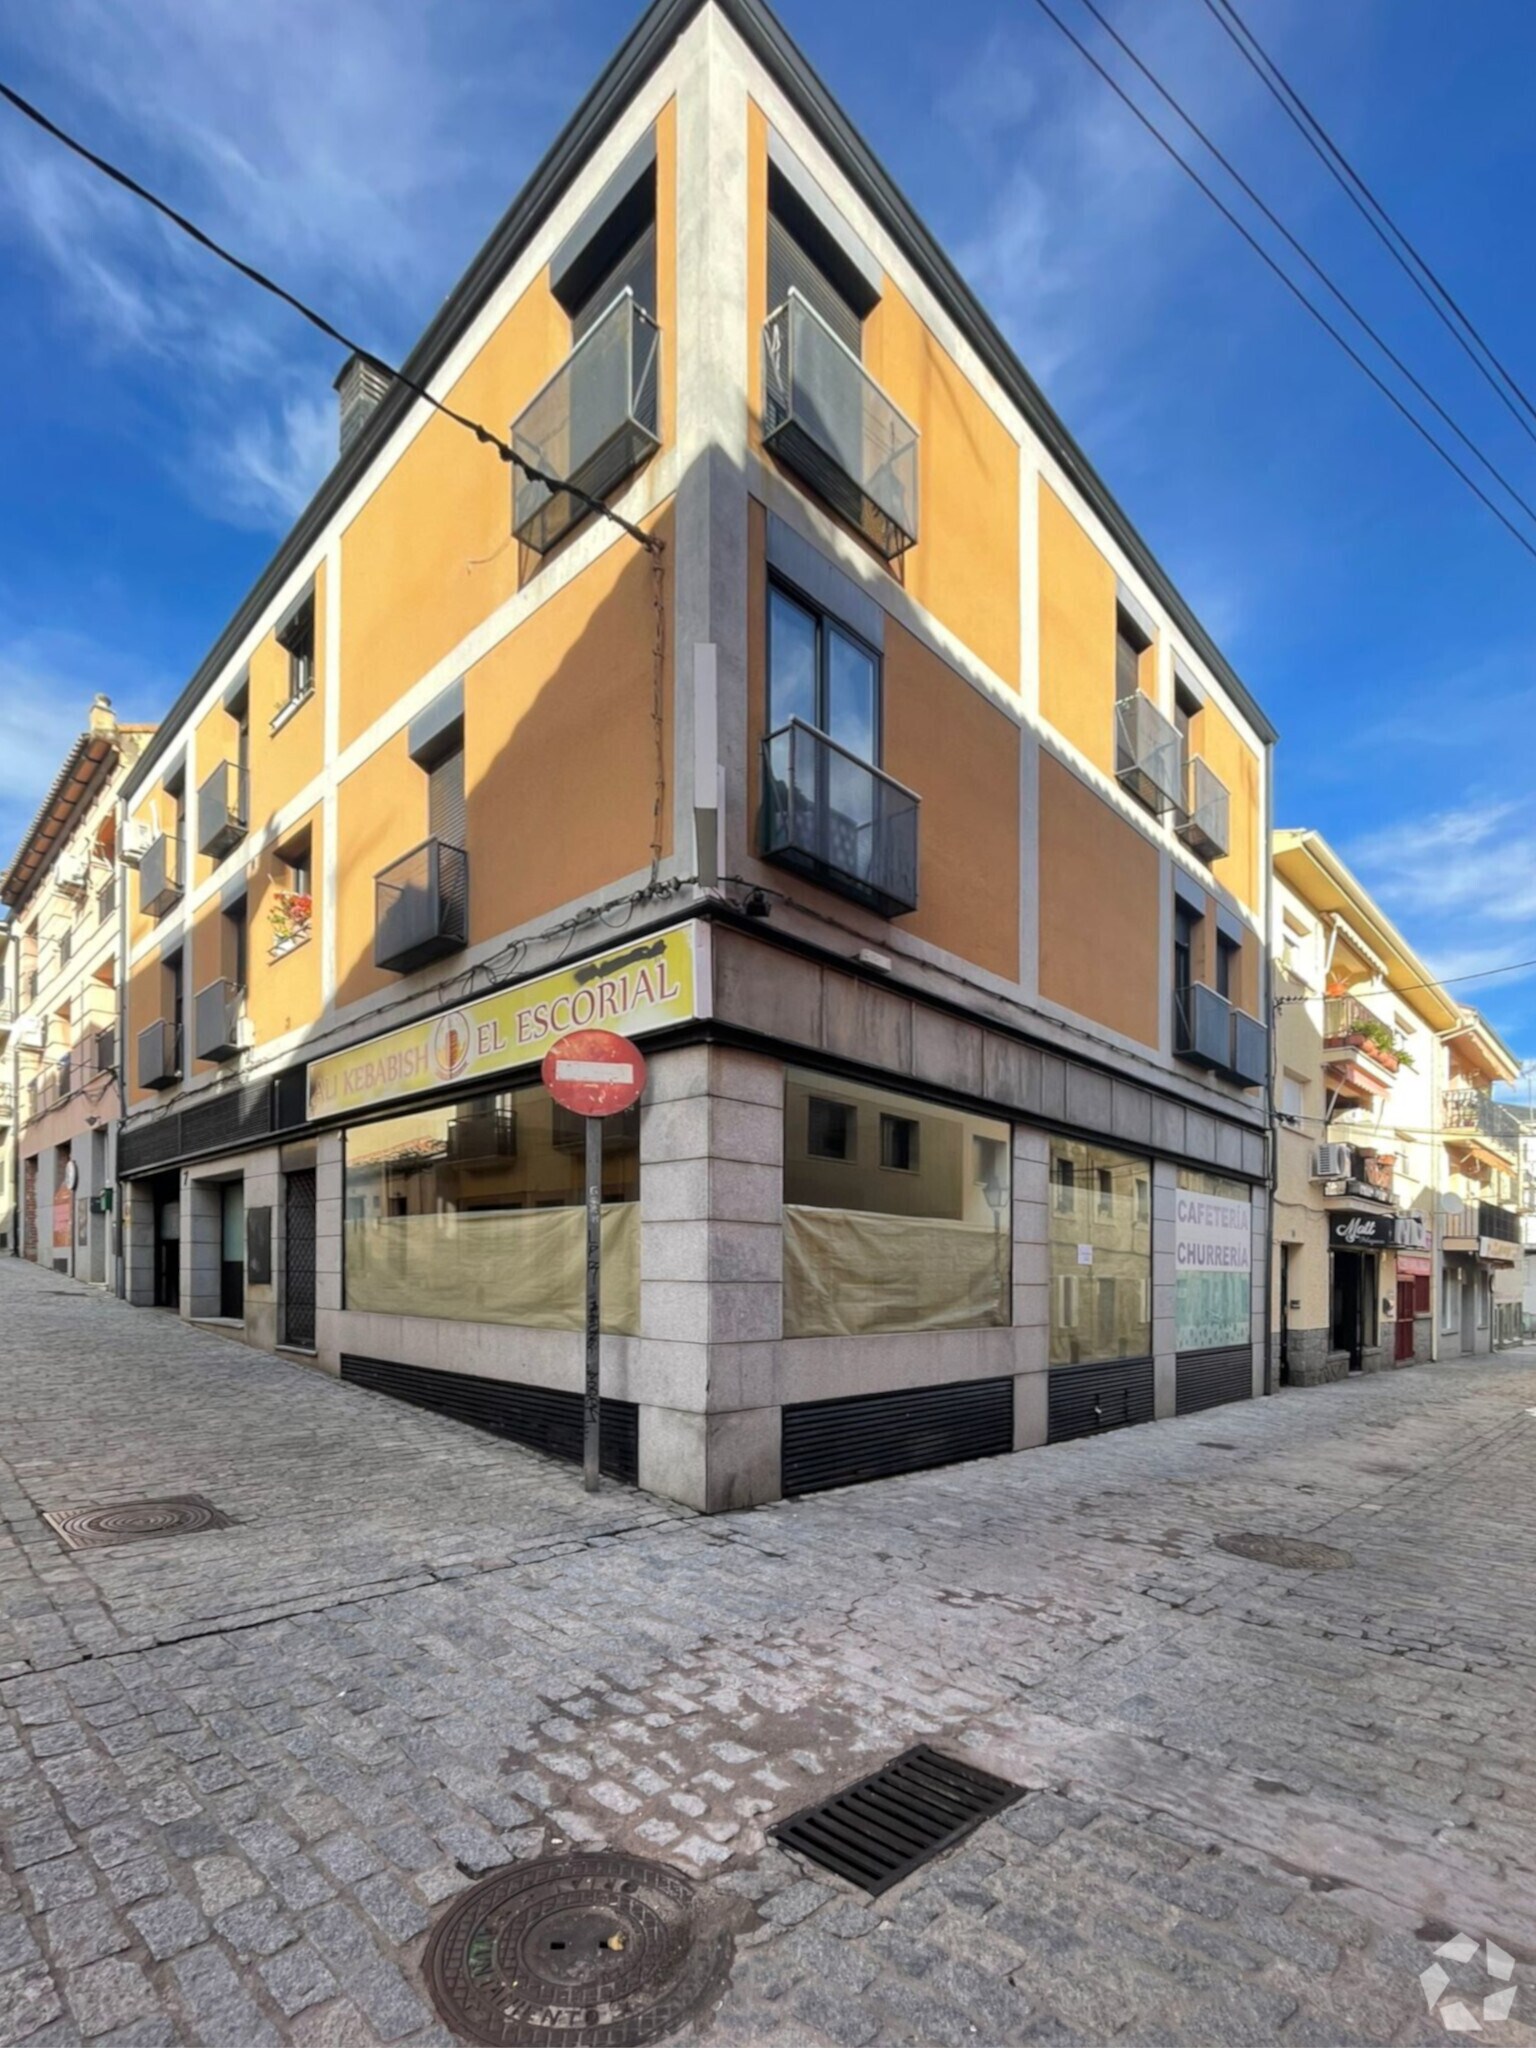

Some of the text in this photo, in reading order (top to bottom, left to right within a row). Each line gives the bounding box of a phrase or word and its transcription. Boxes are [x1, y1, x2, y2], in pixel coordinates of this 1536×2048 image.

[343, 1043, 429, 1097] KEBABISH
[477, 1020, 506, 1056] EL
[516, 963, 679, 1044] ESCORIAL
[1177, 1200, 1248, 1231] CAFETERÍA
[1177, 1241, 1248, 1268] CHURRERÍA
